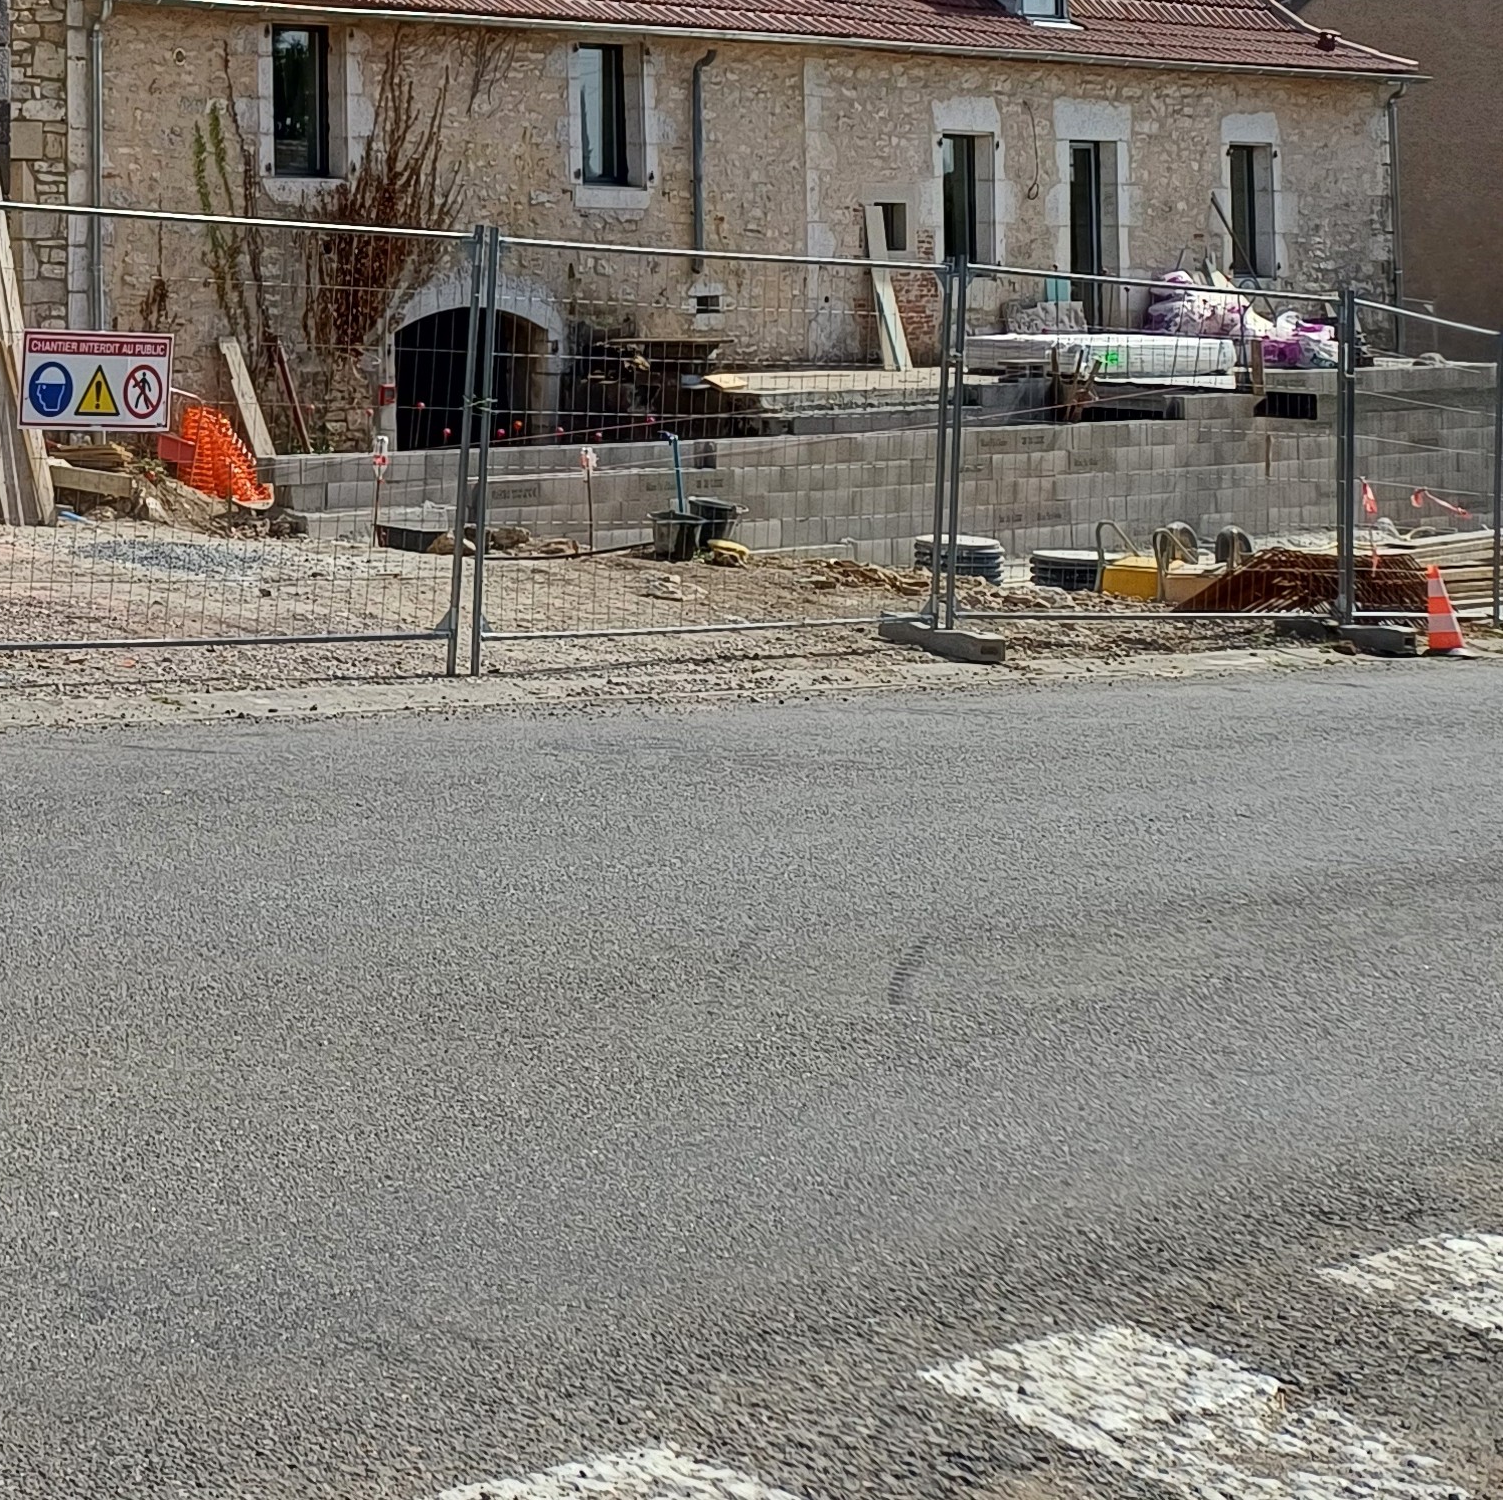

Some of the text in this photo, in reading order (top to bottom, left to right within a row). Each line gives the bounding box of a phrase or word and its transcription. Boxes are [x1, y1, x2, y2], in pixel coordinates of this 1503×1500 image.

[31, 340, 165, 356] CHANTIER INTERDIT AU PUBLIC
